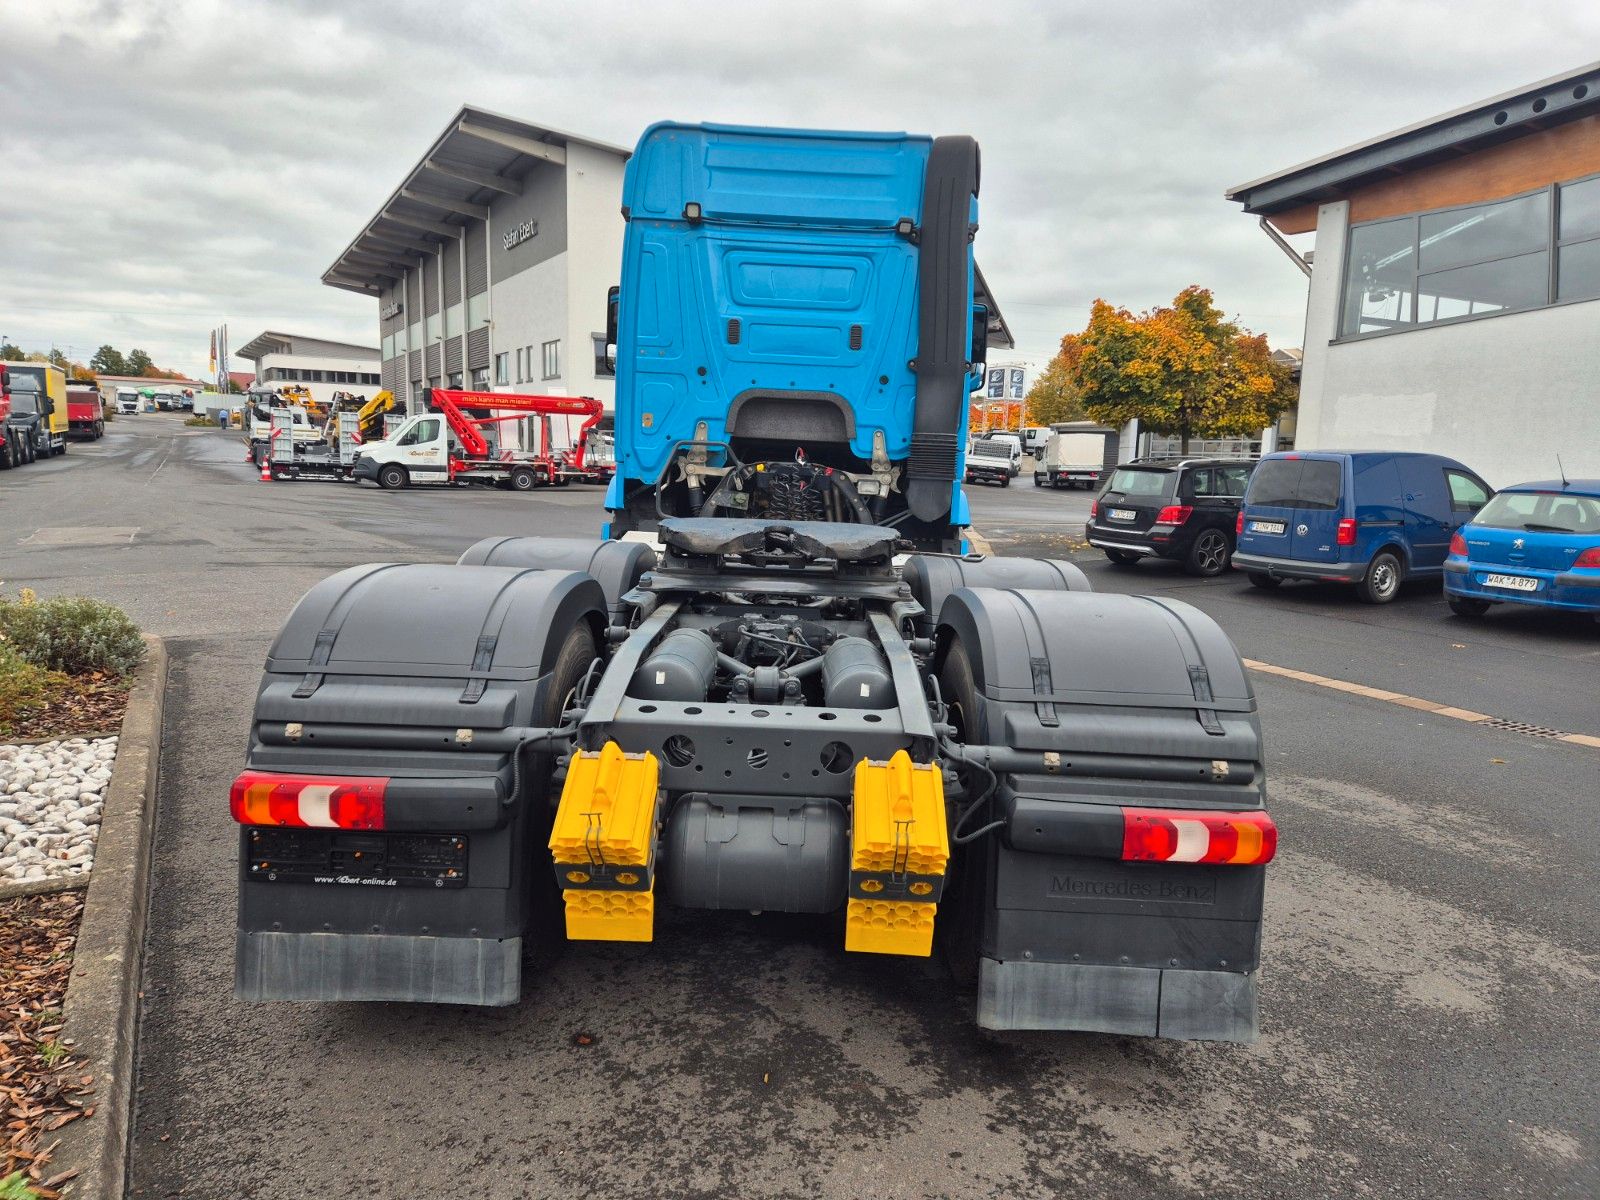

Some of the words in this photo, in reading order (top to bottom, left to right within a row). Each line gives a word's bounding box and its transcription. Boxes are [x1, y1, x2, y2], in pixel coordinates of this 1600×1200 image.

[520, 217, 534, 241] Ebert
[1488, 574, 1505, 585] WAK
[1518, 578, 1536, 588] 879
